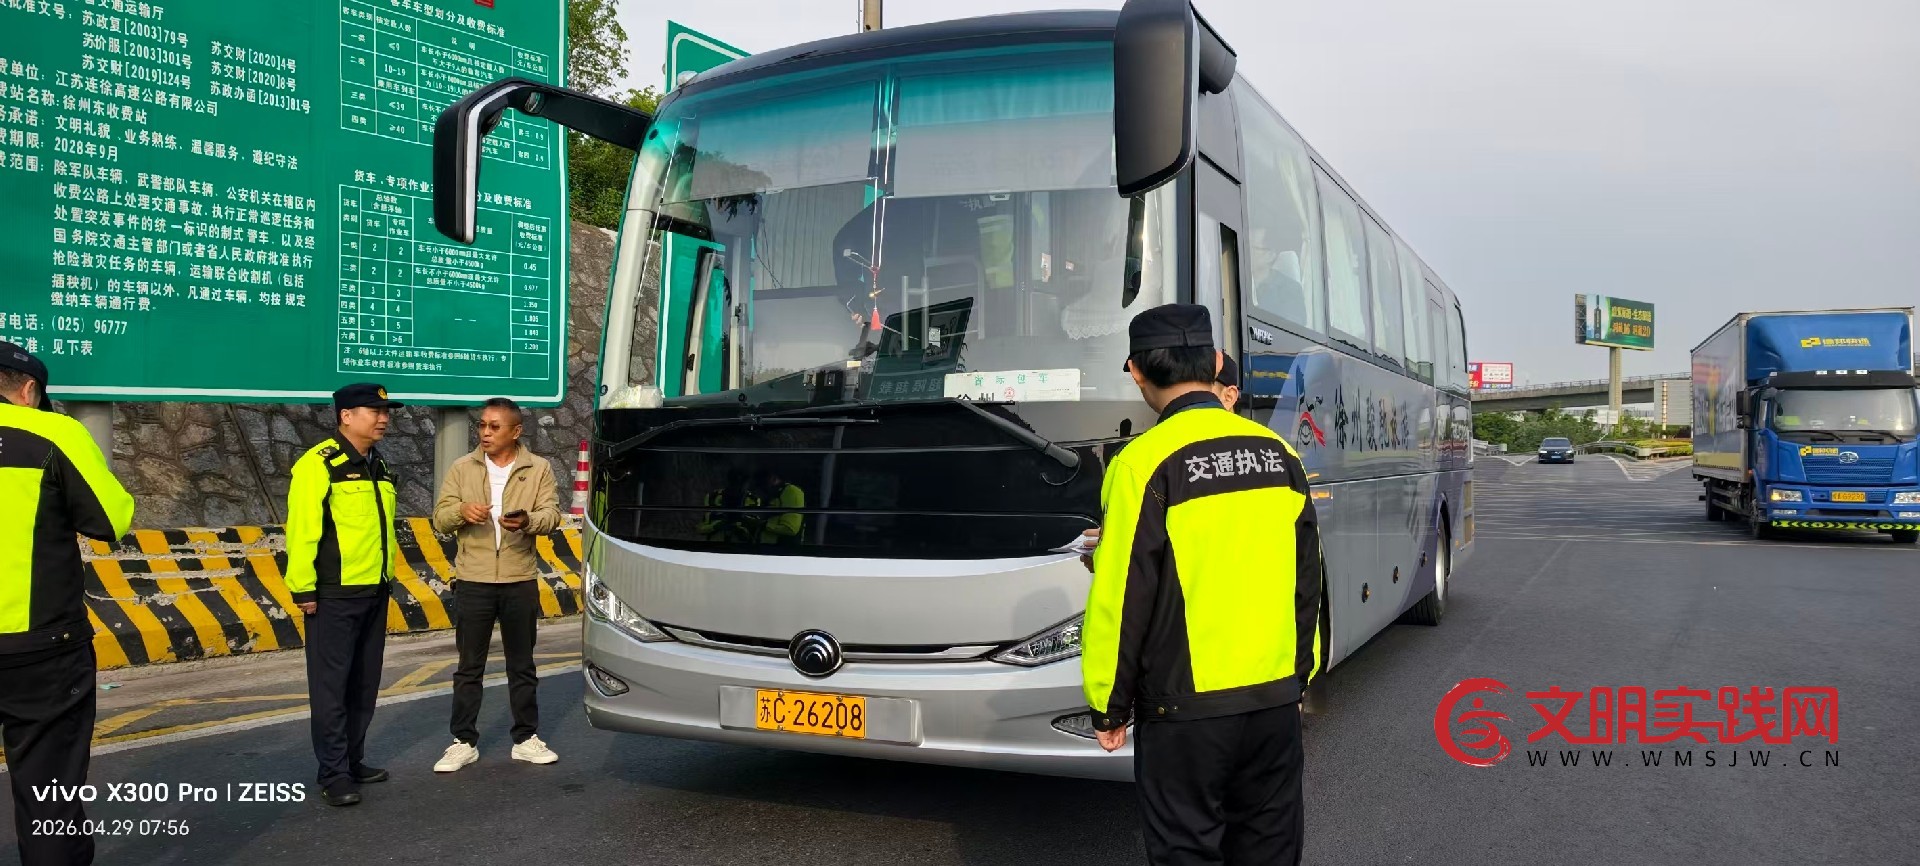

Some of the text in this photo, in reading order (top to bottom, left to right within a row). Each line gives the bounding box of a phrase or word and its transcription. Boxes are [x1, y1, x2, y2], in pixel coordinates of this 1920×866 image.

[82, 10, 188, 48] 苏政复[2003]79号
[211, 41, 296, 73] 苏交财[2020]4号
[82, 32, 296, 92] 苏价服[2003]301号 苏交财[2020]8号
[82, 54, 311, 114] 苏交财[2019]124号 苏政办函[2013]81号
[56, 70, 218, 116] 江苏连徐高速公路有限公司
[54, 137, 118, 162] 2028年9月
[354, 169, 433, 193] 货车、专项作业
[372, 243, 378, 252] 2
[398, 246, 404, 256] 2
[371, 266, 377, 275] 2
[397, 268, 403, 278] 2
[371, 286, 376, 295] 3
[396, 289, 402, 298] 3
[370, 302, 376, 311] 4
[395, 306, 401, 314] 4
[94, 320, 127, 334] 96777
[370, 318, 376, 327] 5
[396, 321, 402, 330] 5
[370, 333, 375, 342] 6
[52, 339, 93, 355] 见下表
[1185, 448, 1285, 483] 交通执法
[760, 696, 863, 732] 苏C·26208
